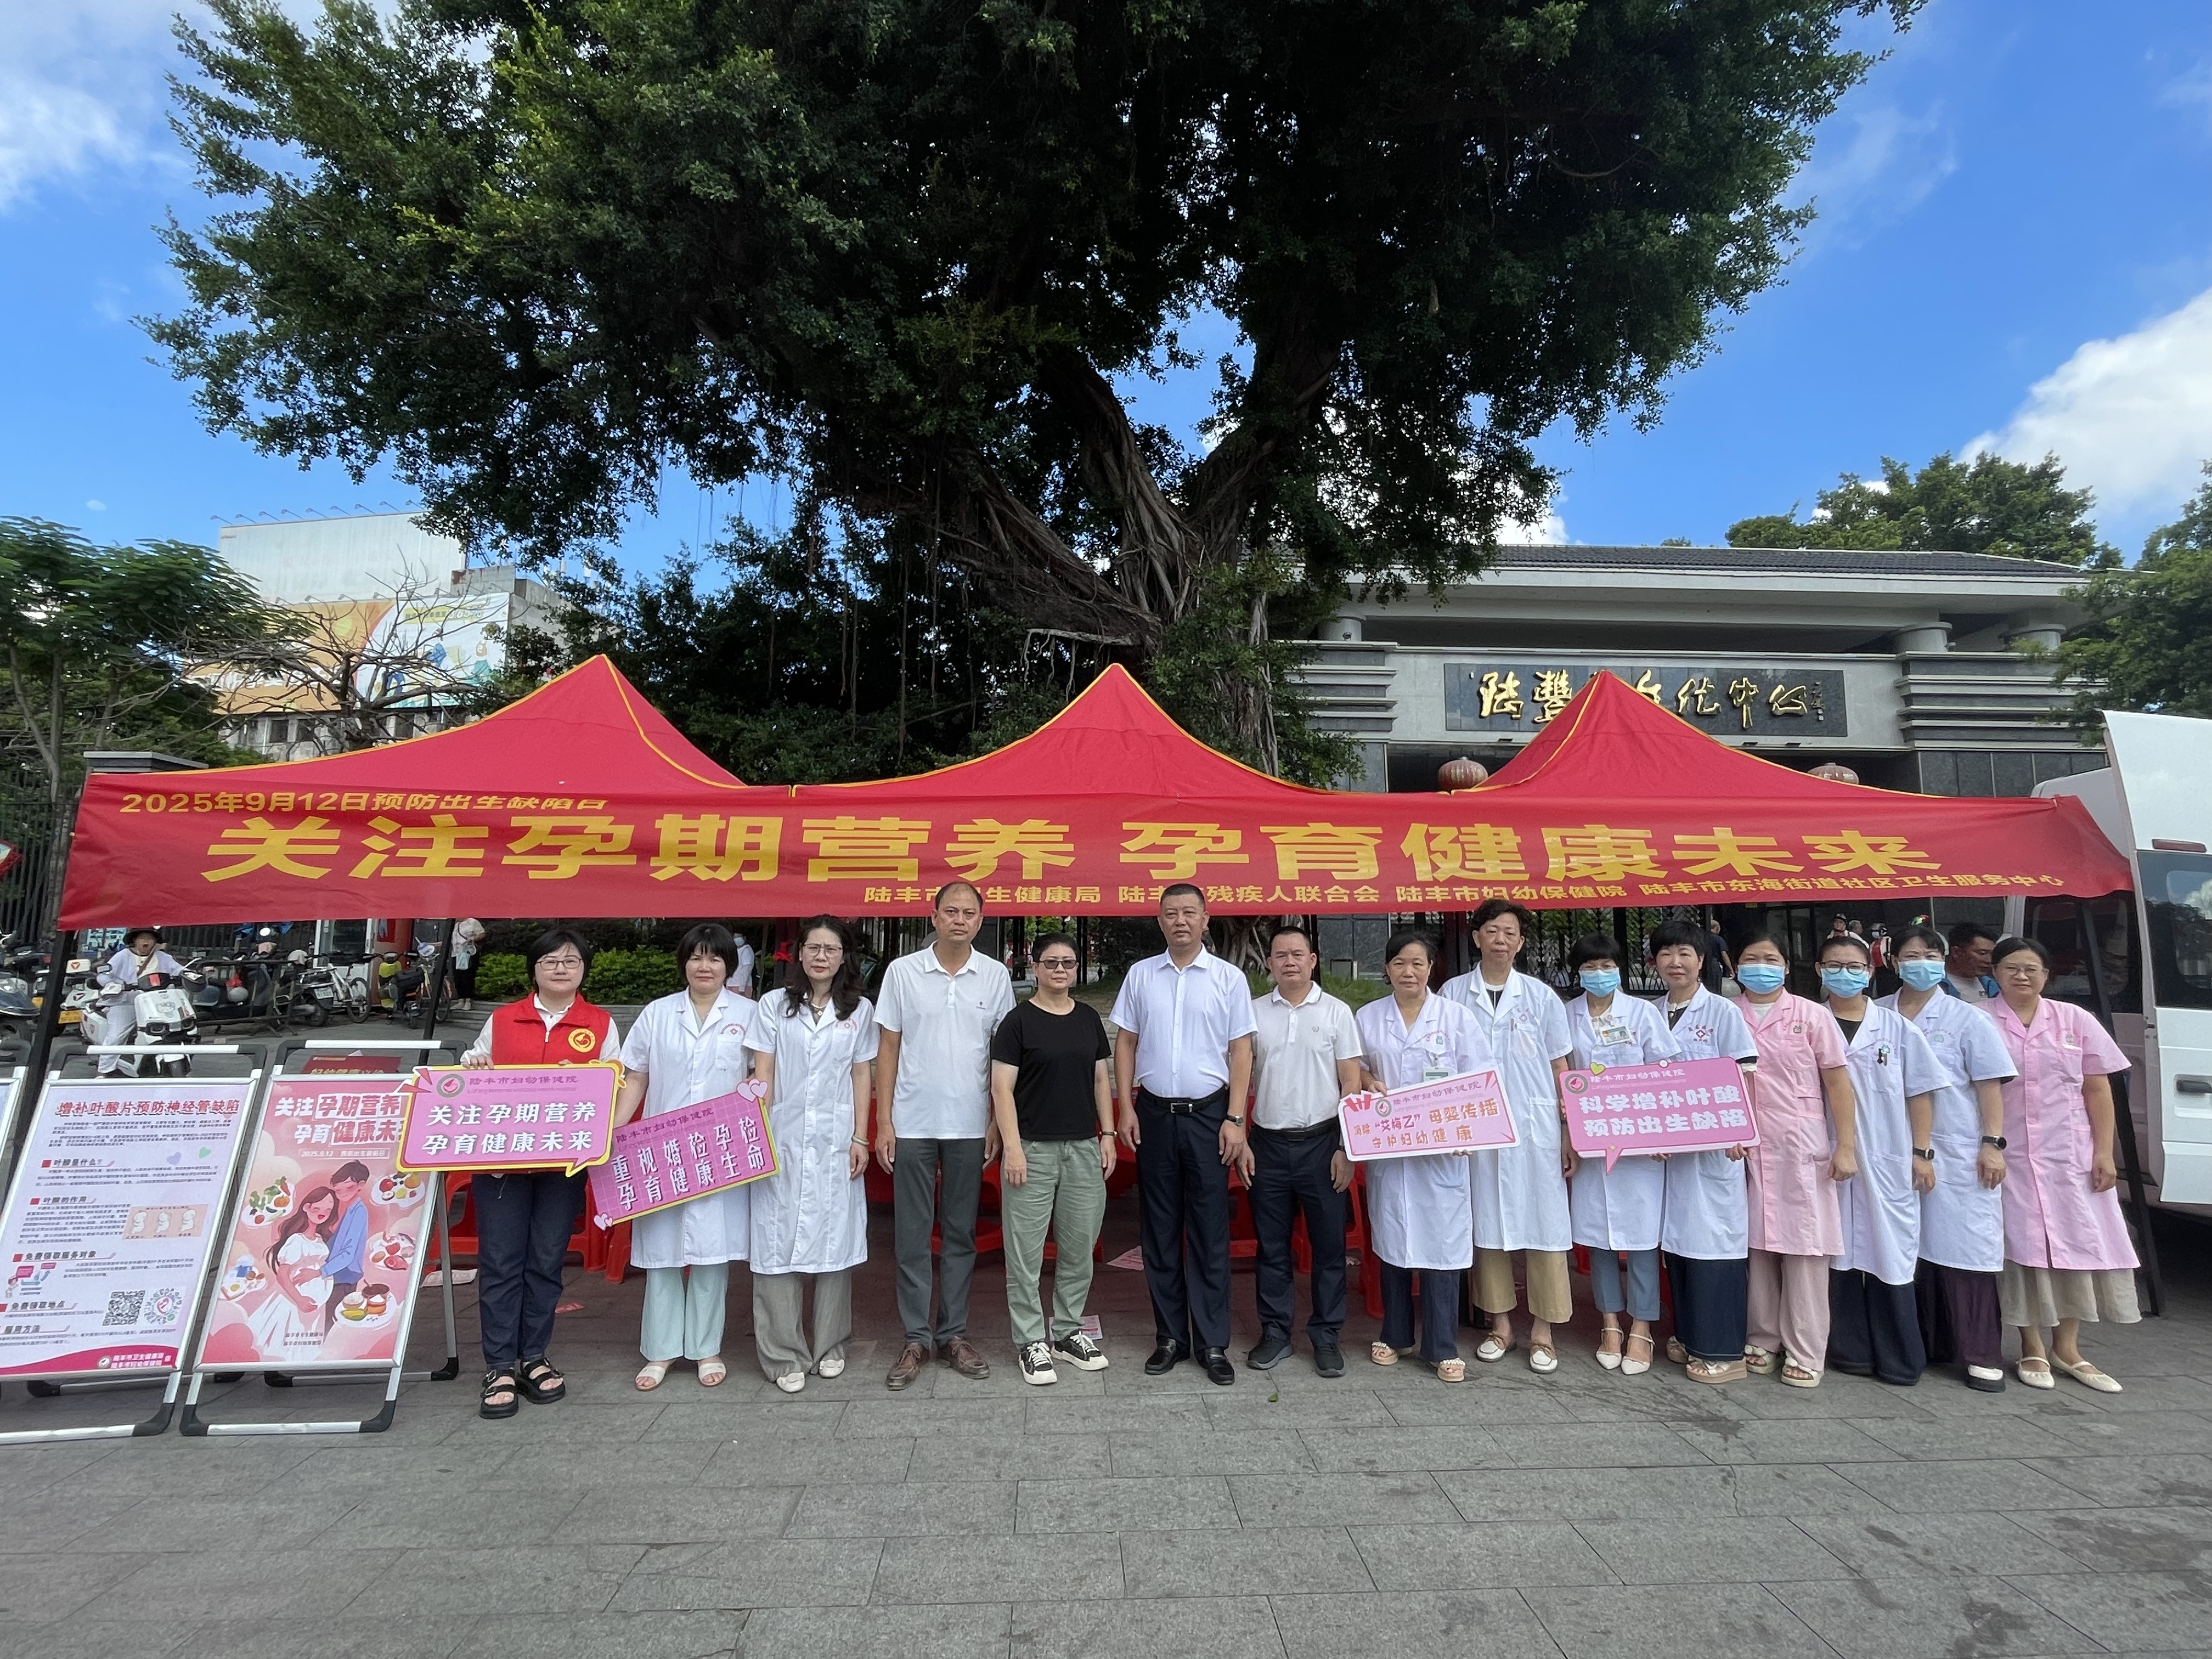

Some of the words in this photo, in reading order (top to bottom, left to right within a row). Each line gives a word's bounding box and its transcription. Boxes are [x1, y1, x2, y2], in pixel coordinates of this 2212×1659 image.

[120, 792, 608, 813] 2025年9月12日预防出生缺陷日
[200, 813, 1075, 882] 关注孕期营养
[1119, 822, 1942, 882] 孕育健康未来
[864, 886, 1101, 903] 陆丰生健康局
[1118, 885, 1380, 903] 陆丰残疾人联合会
[1395, 885, 1628, 903] 陆丰市妇幼保健院
[1638, 874, 2064, 895] 陆丰市东海街道社区卫生服务中心
[56, 1099, 240, 1116] 增补叶酸片预防神经管缺陷
[274, 1094, 400, 1118] 关注孕期营养
[426, 1101, 596, 1126] 关注孕期营养
[1429, 1097, 1500, 1125] 母婴传播
[1578, 1085, 1741, 1114] 科学增补叶酸
[1583, 1108, 1748, 1138] 预防出生缺陷
[421, 1130, 593, 1155] 孕育健康未来
[611, 1116, 761, 1183] 重视婚检孕检
[617, 1144, 766, 1211] 孕育健康生命
